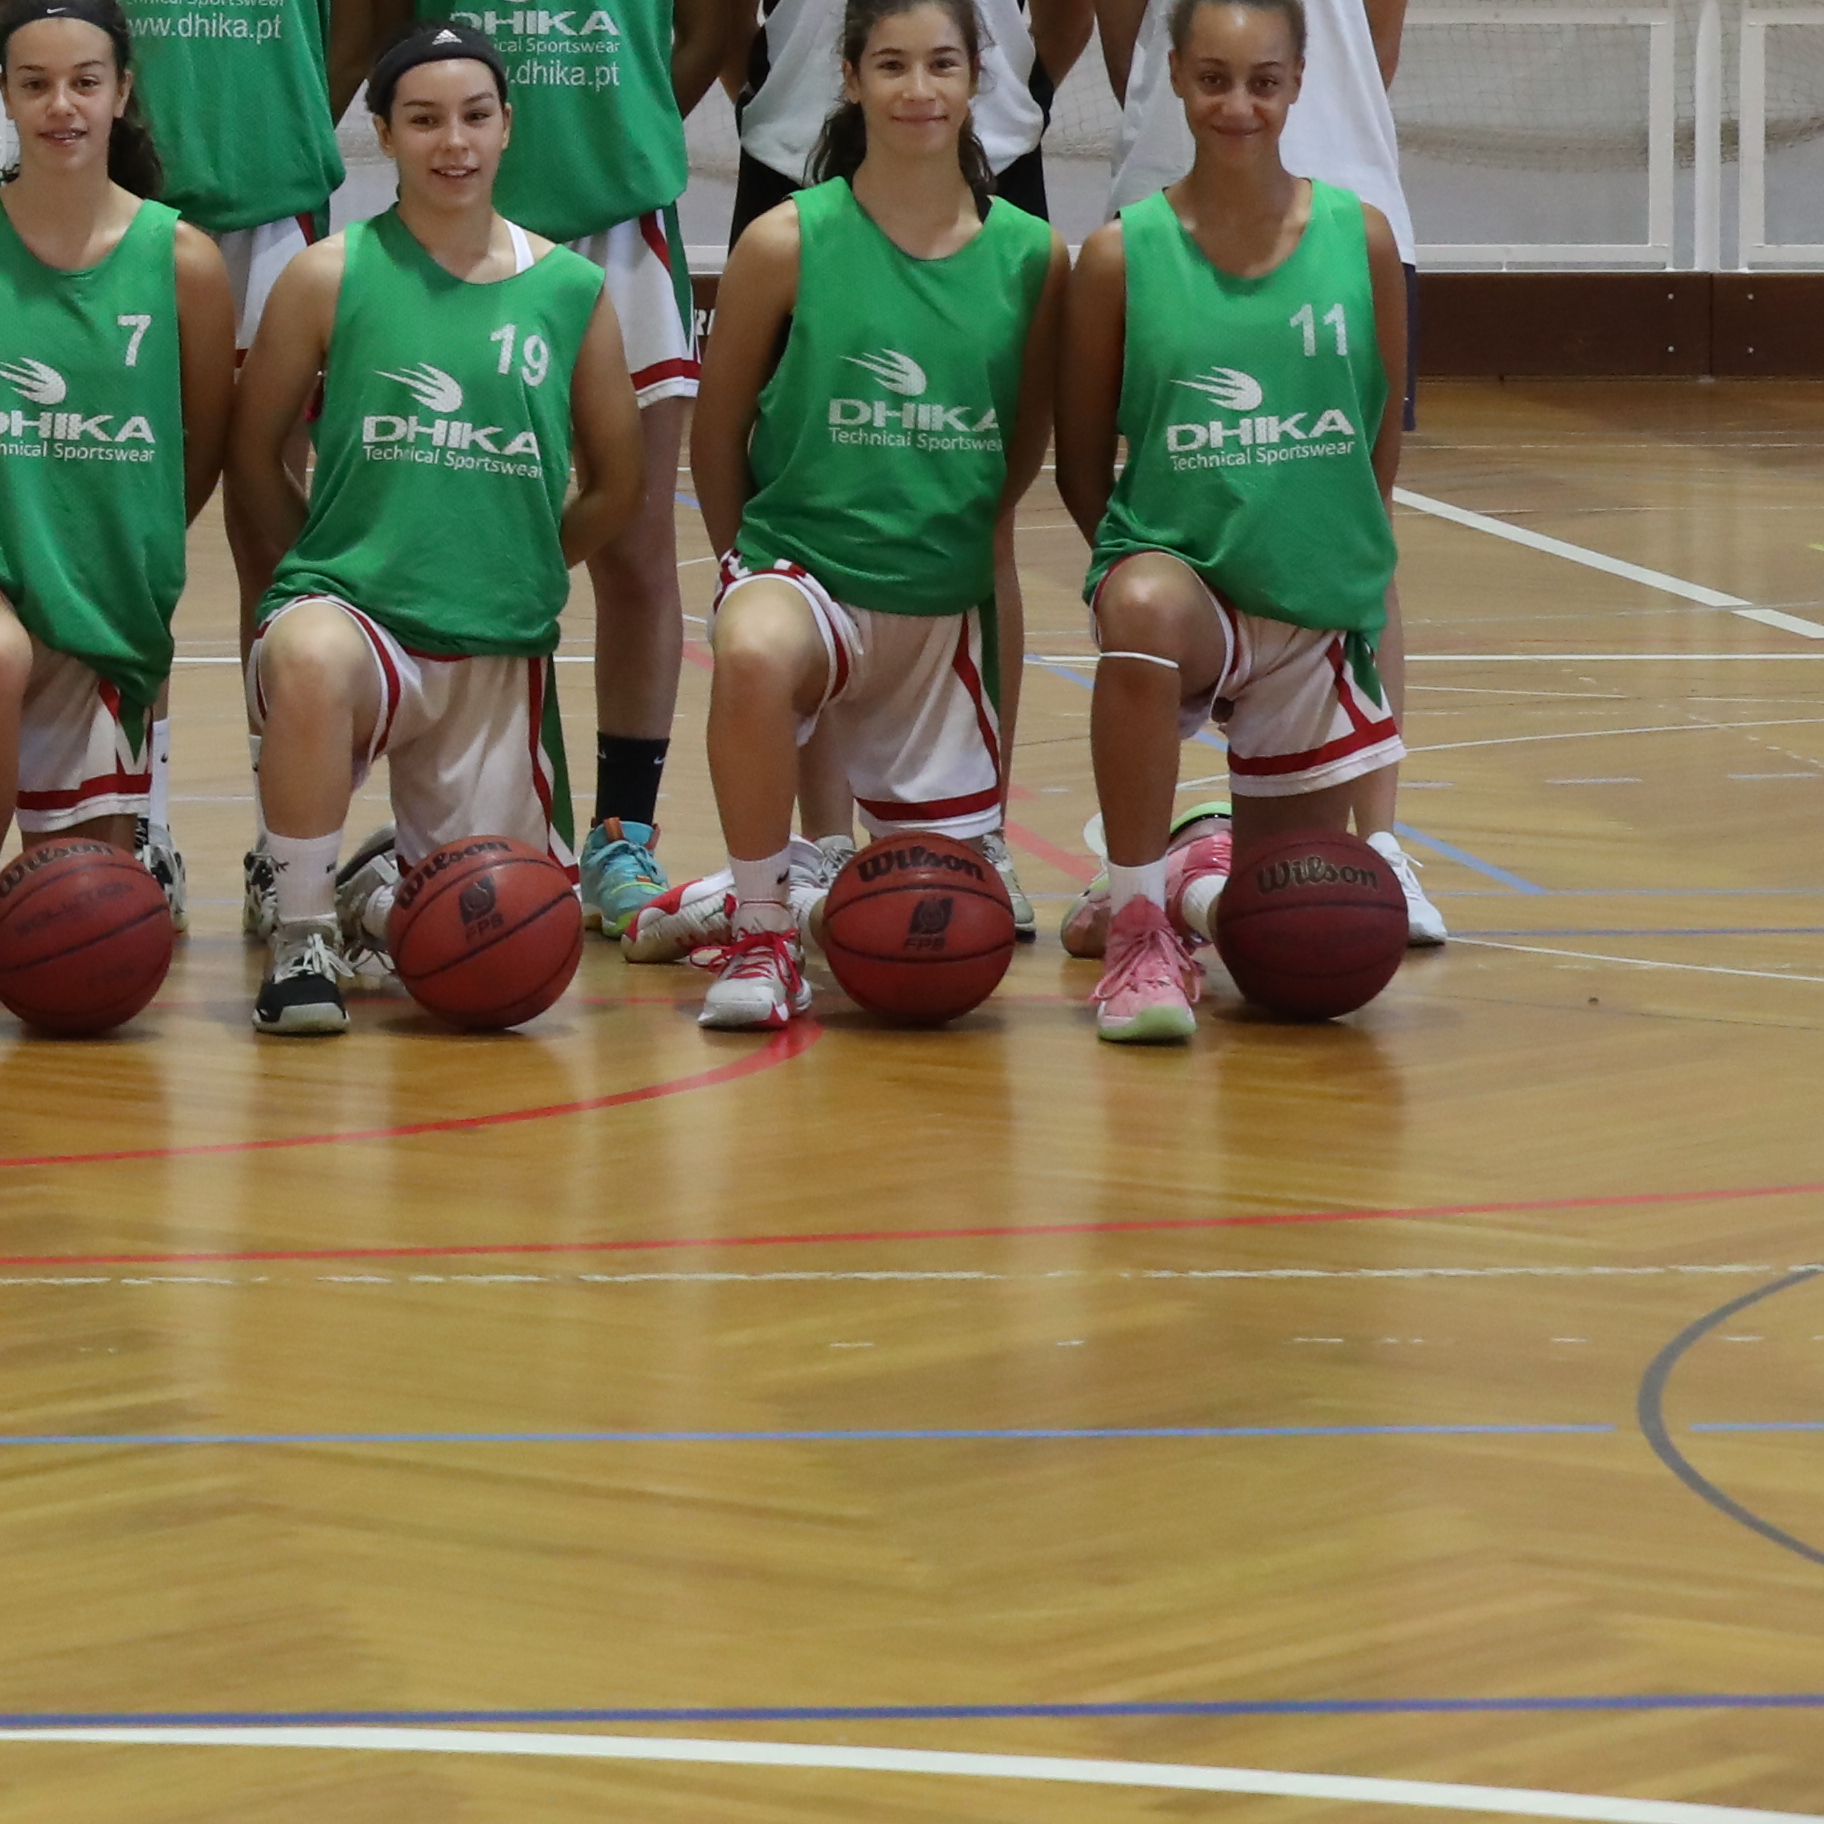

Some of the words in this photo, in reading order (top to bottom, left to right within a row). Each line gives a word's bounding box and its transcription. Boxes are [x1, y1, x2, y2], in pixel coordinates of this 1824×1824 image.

[526, 38, 620, 54] Sportswear
[117, 314, 152, 366] 7
[1289, 303, 1348, 356] 11
[489, 323, 549, 387] 19
[828, 398, 1000, 432] DHIKA
[1166, 408, 1356, 453] DHIKA
[53, 442, 155, 461] Sportswear
[362, 415, 540, 461] DHIKA
[828, 427, 912, 447] Technical
[1170, 448, 1252, 471] Technical
[1256, 440, 1356, 465] Sportswear
[397, 841, 513, 910] Wilson
[856, 845, 986, 882] Wilson
[1256, 855, 1380, 896] Wilson
